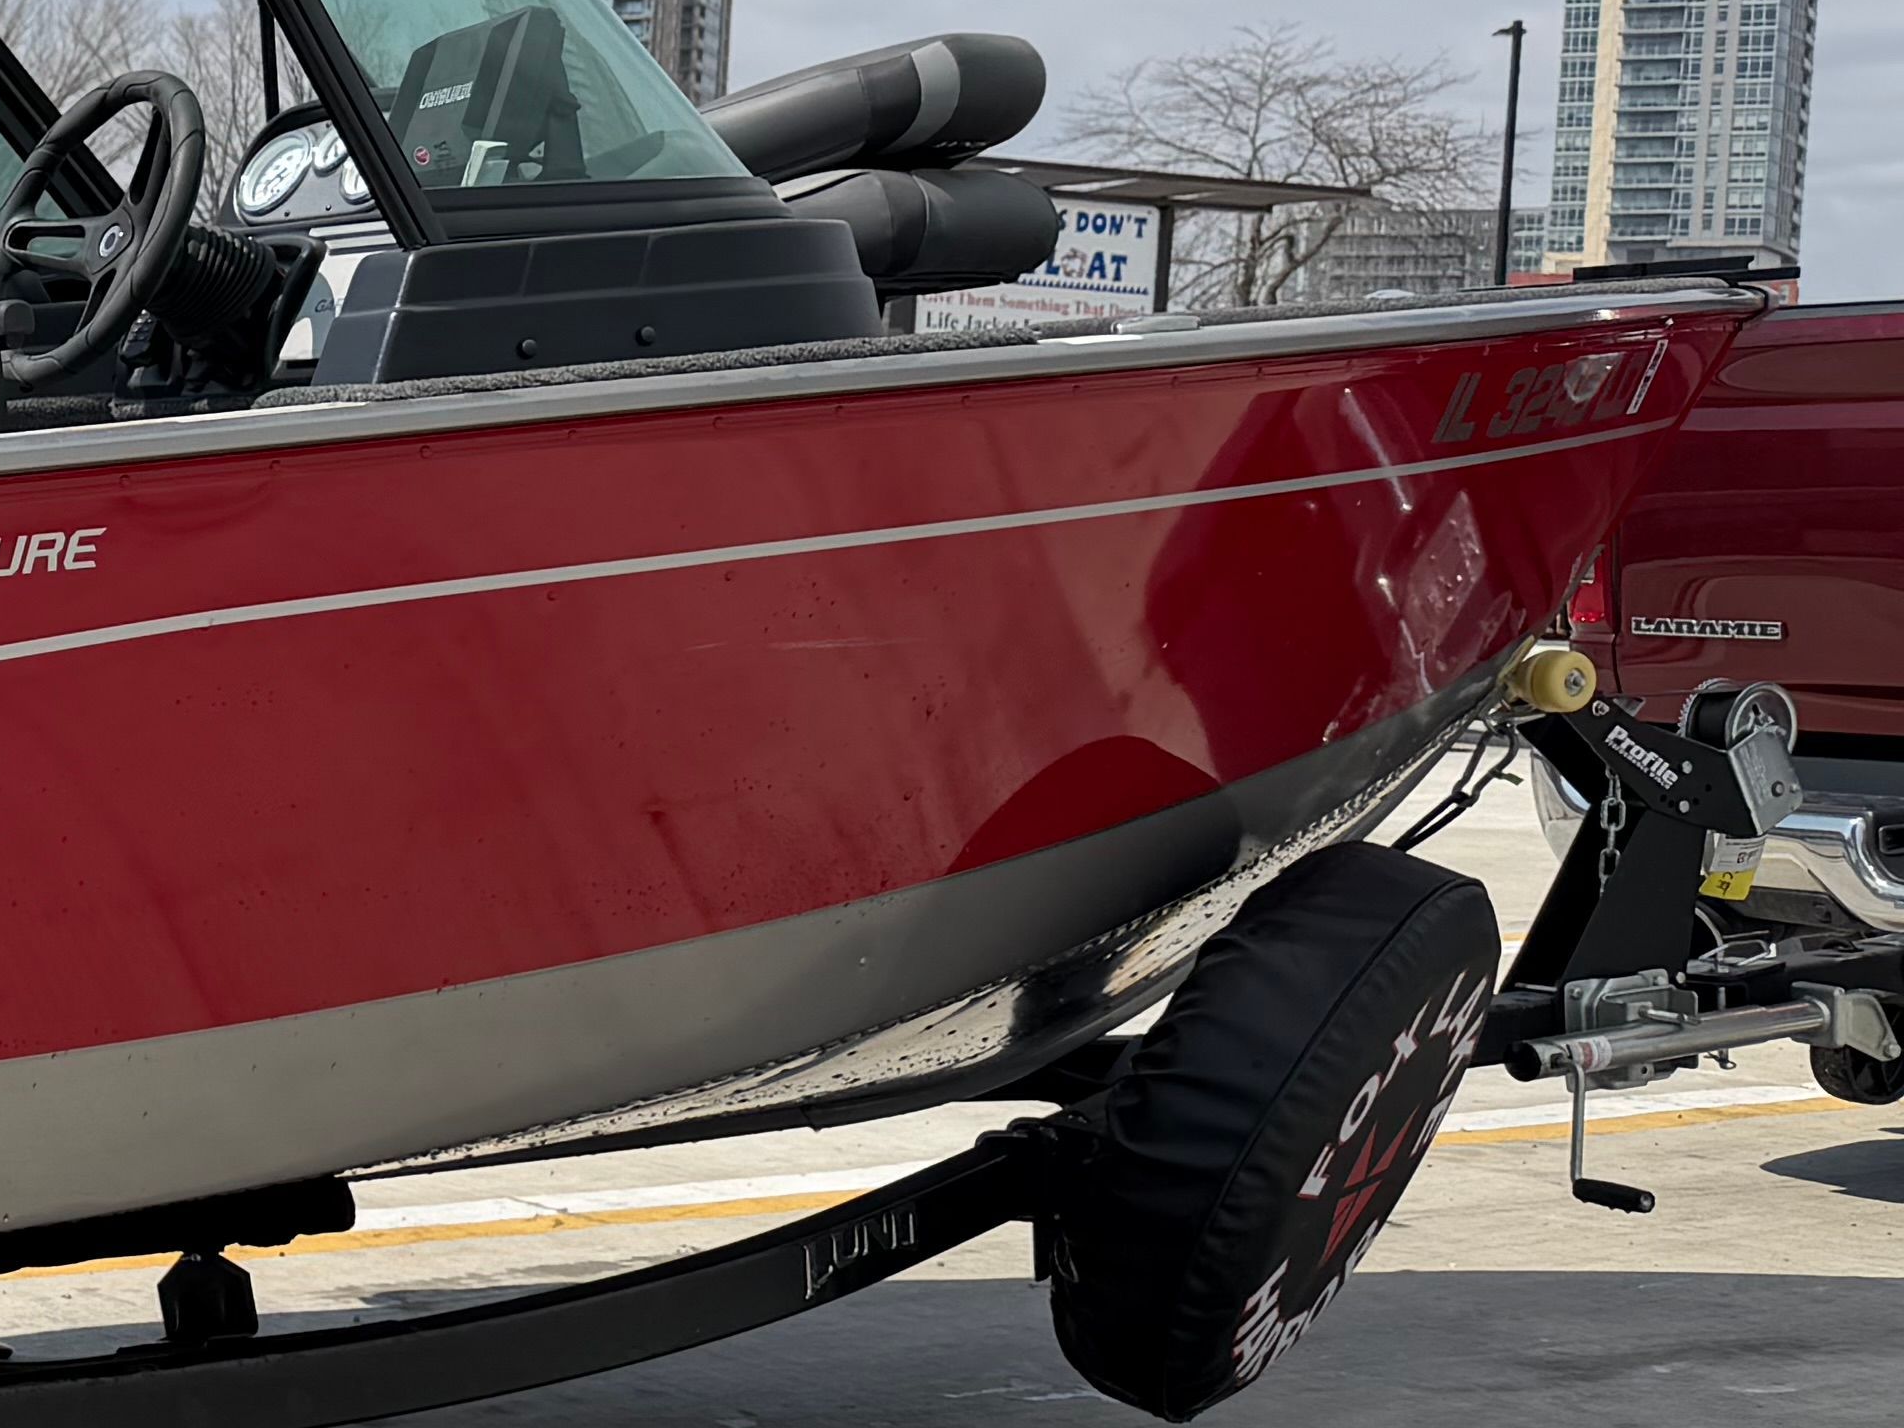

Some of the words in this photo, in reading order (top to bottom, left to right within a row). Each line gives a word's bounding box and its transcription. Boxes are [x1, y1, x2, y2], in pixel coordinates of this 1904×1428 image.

[1074, 210, 1149, 239] DON'T
[959, 292, 996, 308] Them
[1000, 295, 1070, 316] Something
[1075, 300, 1106, 317] That
[927, 311, 958, 330] Life
[1431, 372, 1483, 443] IL
[1631, 616, 1782, 640] LARAMIE
[1606, 724, 1680, 784] Profile
[1297, 998, 1431, 1200] FOX
